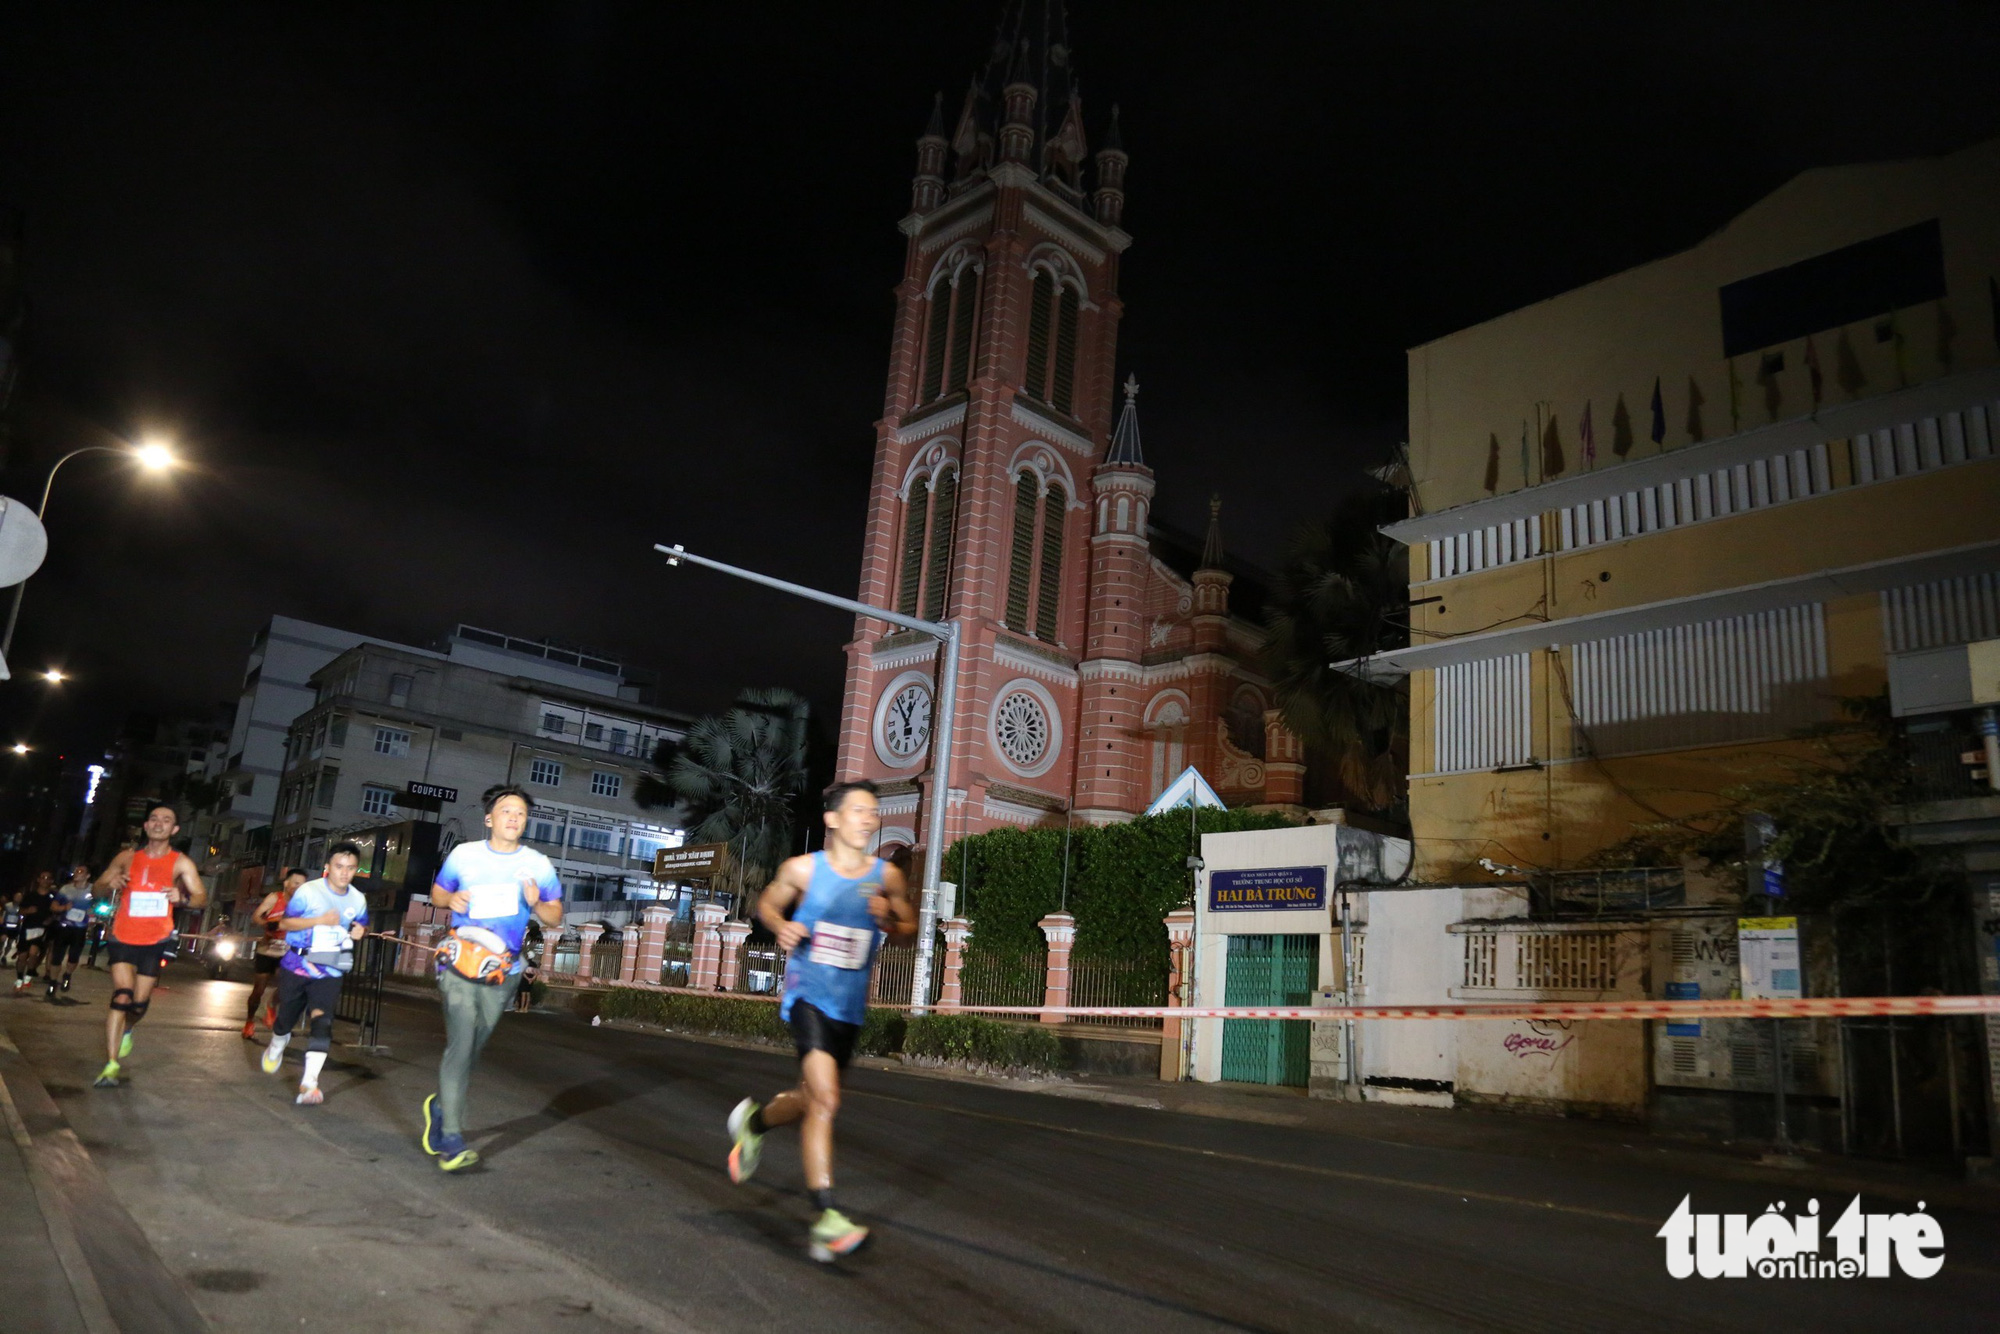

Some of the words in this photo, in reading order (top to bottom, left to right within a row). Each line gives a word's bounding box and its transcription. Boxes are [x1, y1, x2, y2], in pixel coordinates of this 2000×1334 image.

[412, 784, 443, 798] COUPLE
[445, 790, 455, 800] TX
[1217, 889, 1243, 902] HAI
[1246, 886, 1264, 901] BÀ
[1266, 886, 1316, 900] TRƯNG
